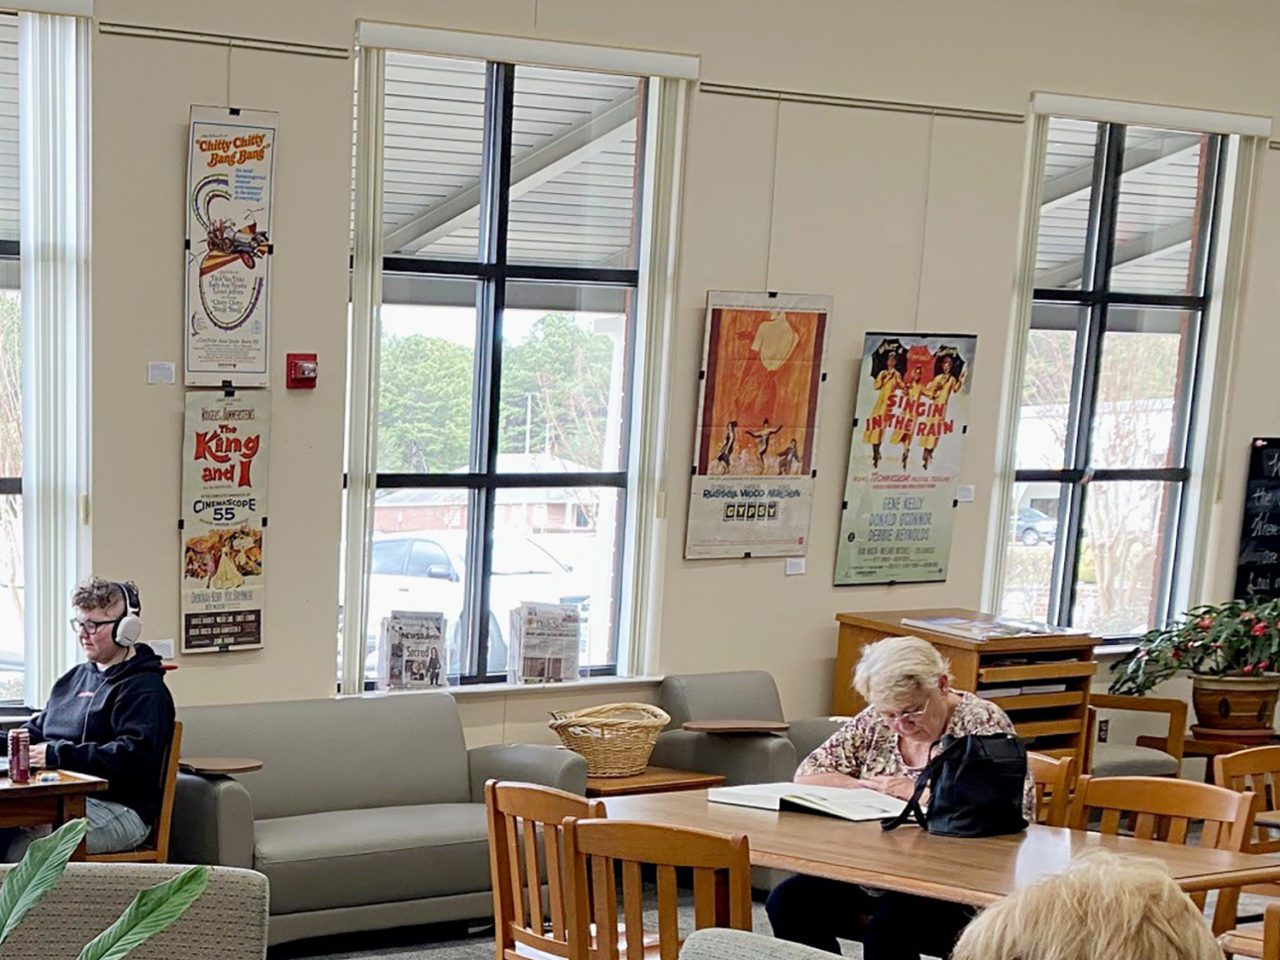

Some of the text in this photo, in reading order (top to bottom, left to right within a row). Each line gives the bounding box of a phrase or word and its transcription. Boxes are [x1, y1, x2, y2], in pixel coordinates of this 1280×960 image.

[233, 133, 266, 149] Chitty
[207, 151, 237, 168] Bang
[218, 424, 238, 434] The
[866, 413, 954, 437] IN THE RAIN
[193, 430, 261, 464] King
[201, 459, 252, 488] and I
[739, 489, 765, 498] WOOD
[903, 496, 926, 510] KELLY
[213, 507, 236, 521] 55
[727, 505, 776, 518] GYPSY
